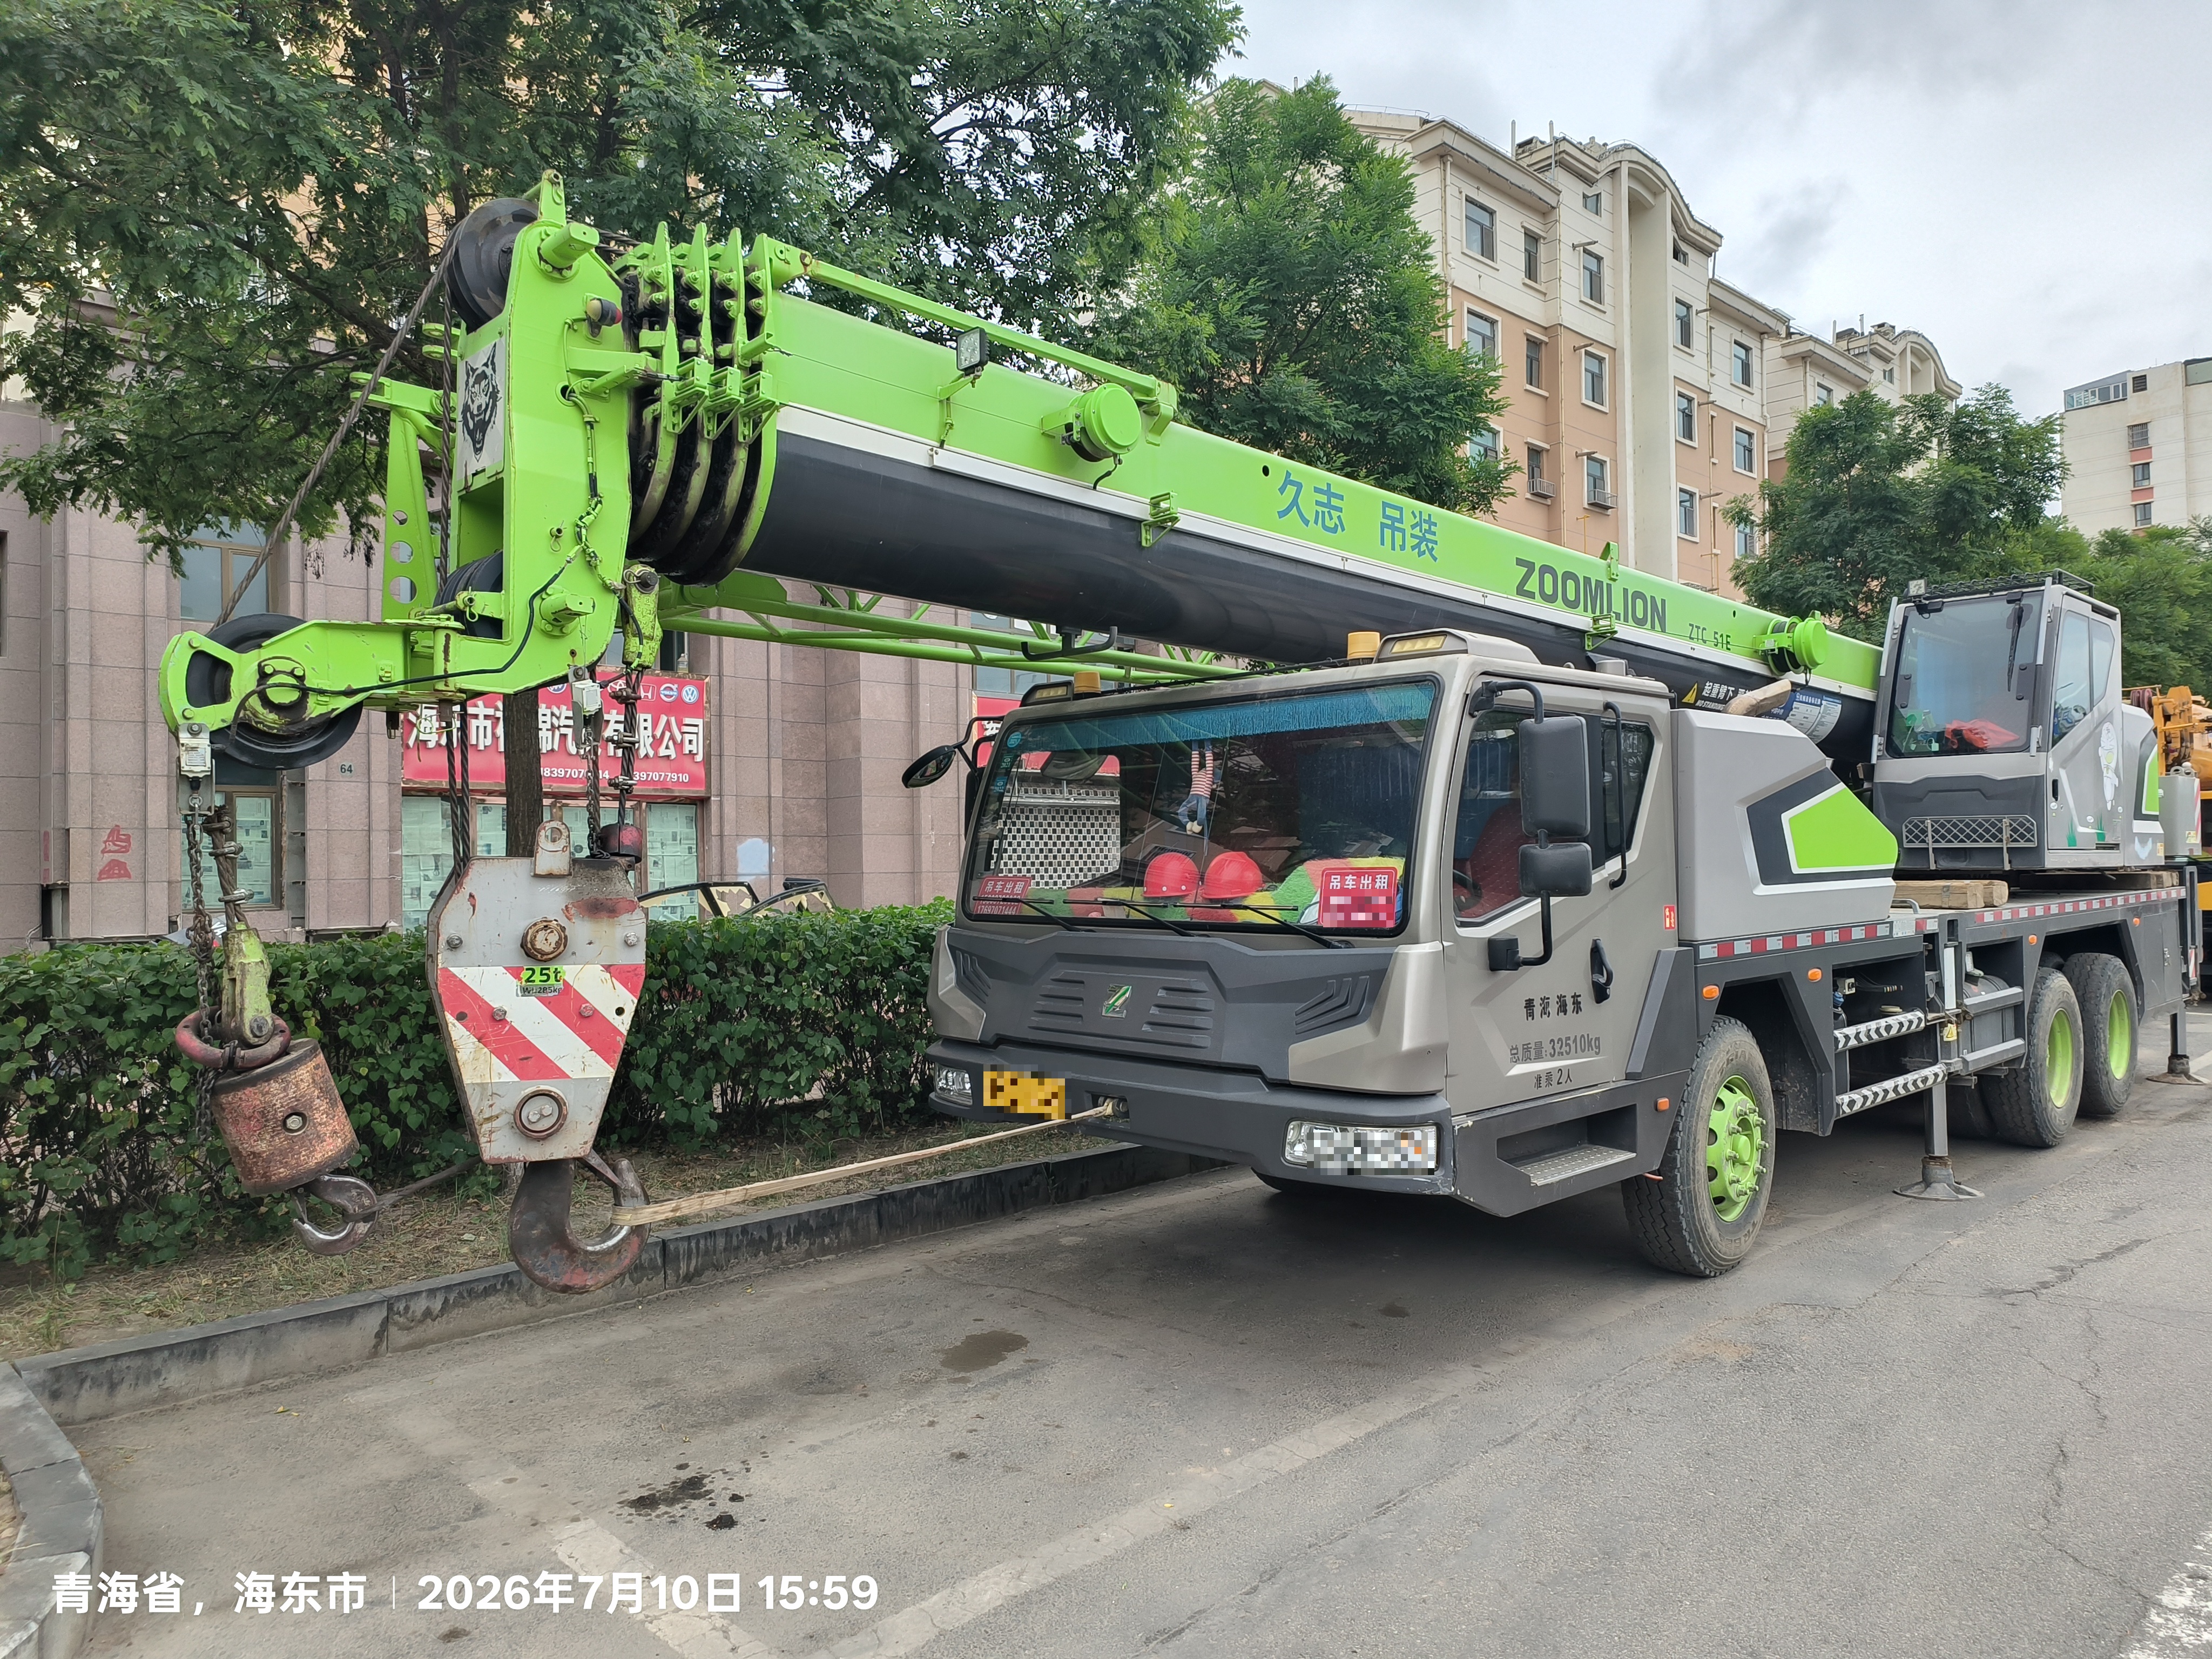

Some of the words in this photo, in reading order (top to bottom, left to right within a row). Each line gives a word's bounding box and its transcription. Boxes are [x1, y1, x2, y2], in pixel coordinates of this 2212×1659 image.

[1277, 470, 1345, 534] 久志
[1380, 501, 1439, 562] 吊装
[1515, 557, 1667, 633] ZOOMLION
[1688, 623, 1708, 644] ZTC
[1702, 681, 1735, 701] 起重臂下
[340, 764, 353, 774] 64
[541, 767, 610, 779] 183970714
[984, 881, 1025, 894] 吊车出租
[1329, 874, 1389, 889] 吊车出租
[525, 967, 561, 983] 25t
[1534, 1068, 1572, 1090] 准乘2人
